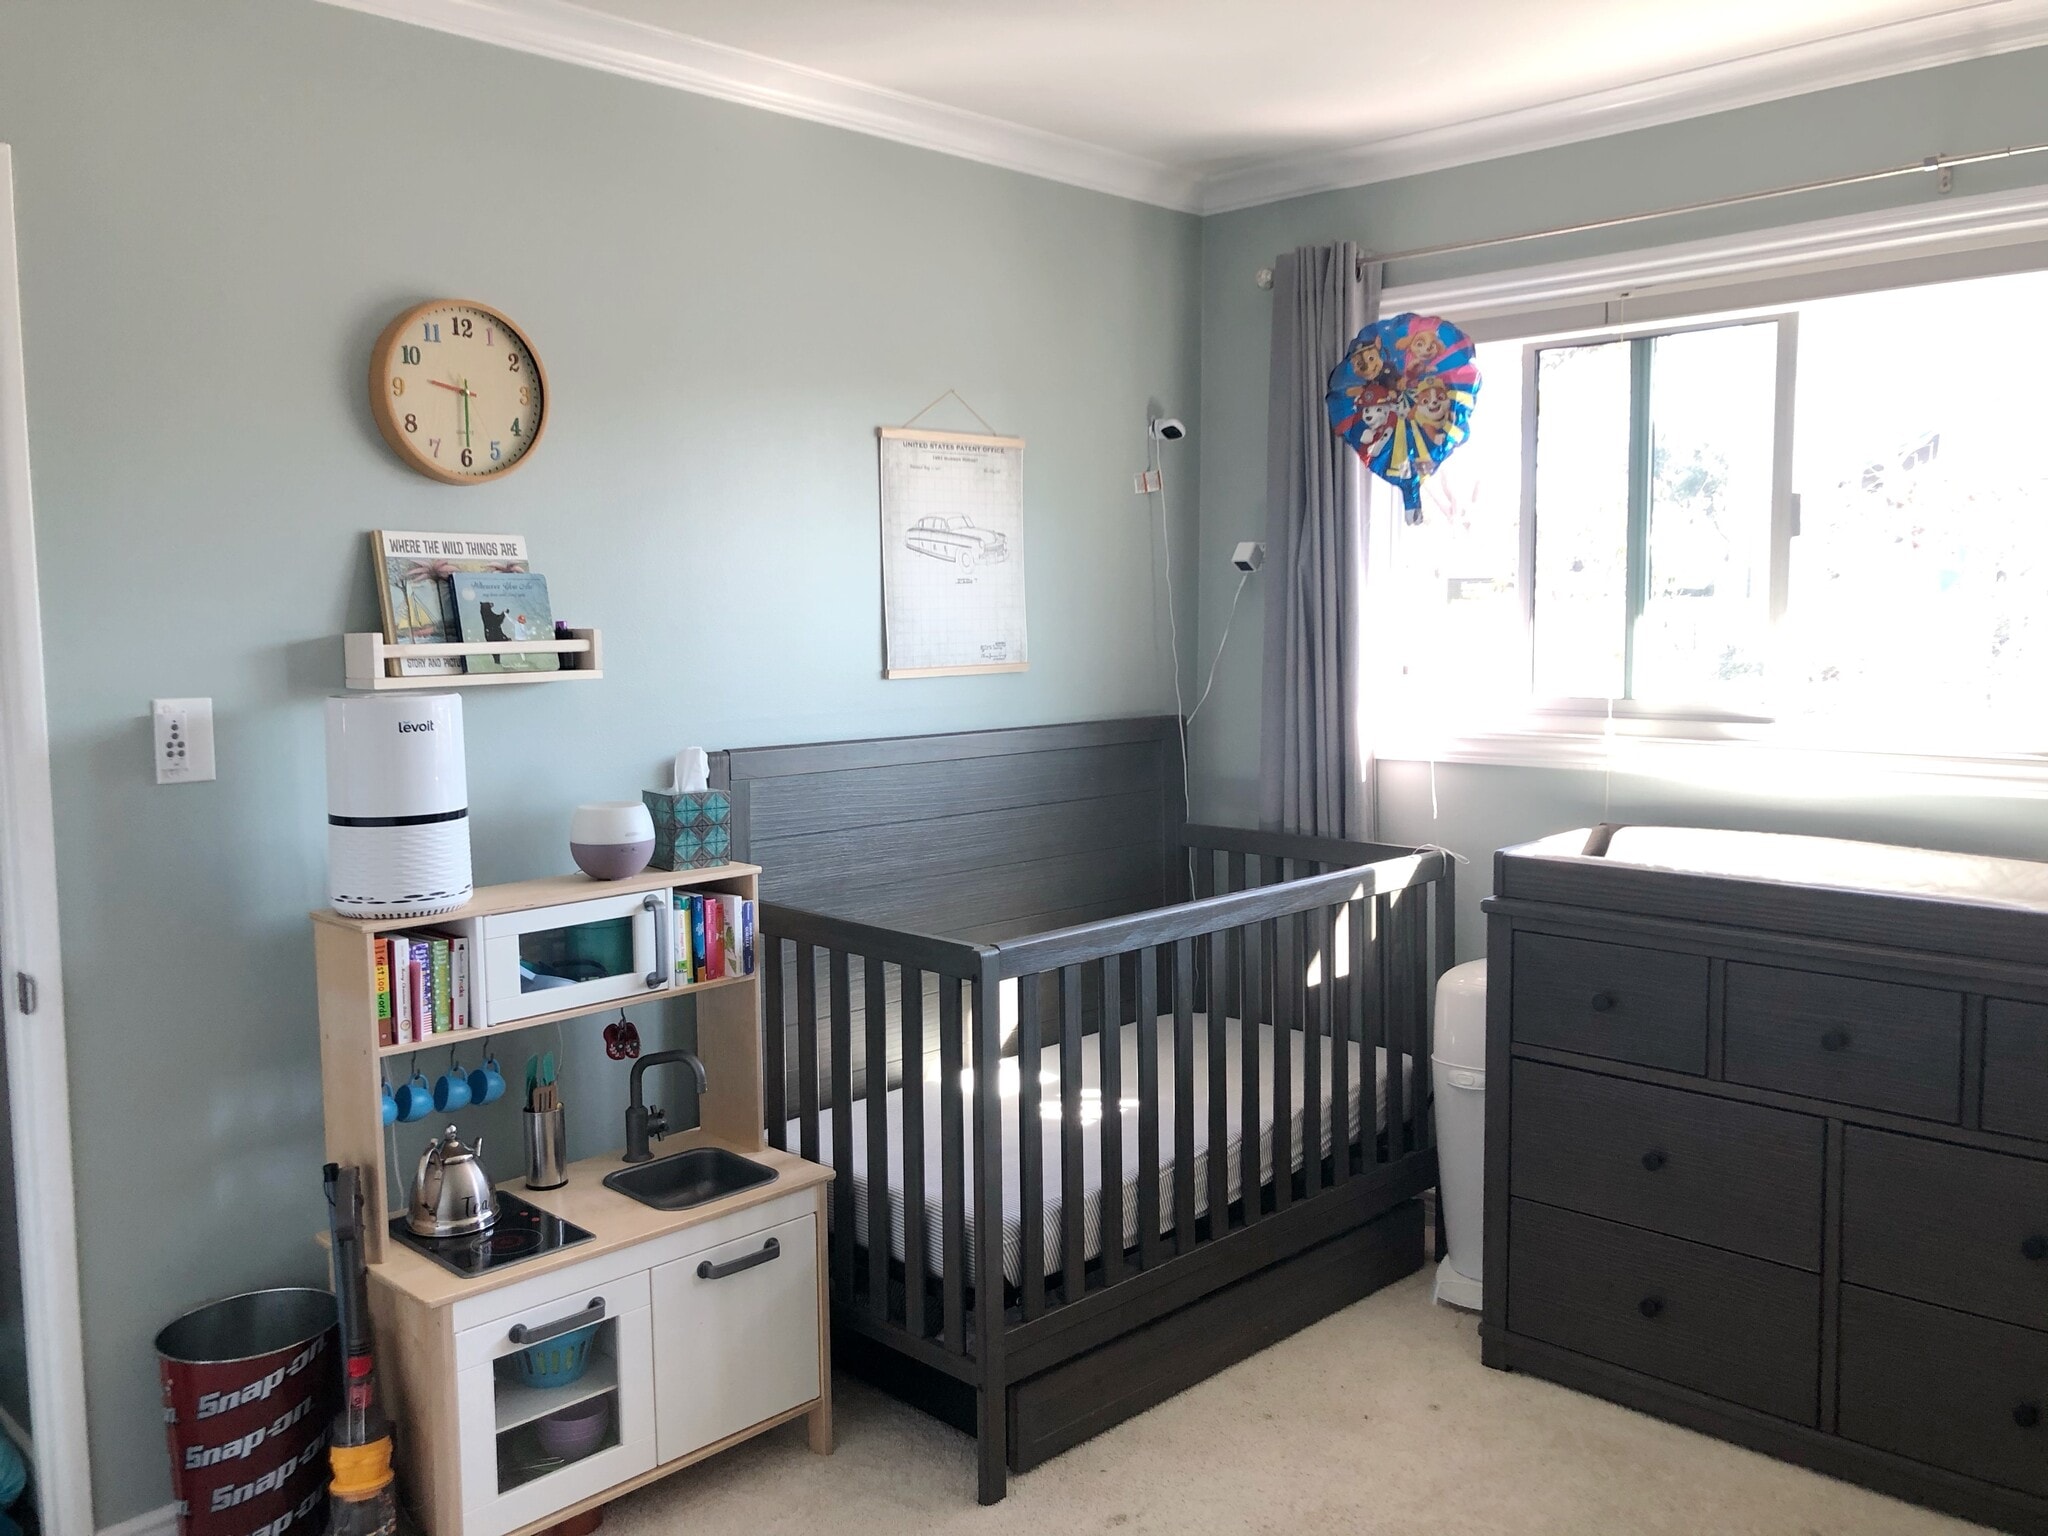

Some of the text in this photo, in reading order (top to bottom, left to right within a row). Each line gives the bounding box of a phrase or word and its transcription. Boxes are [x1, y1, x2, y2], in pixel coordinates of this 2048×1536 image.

[423, 322, 441, 343] 11
[451, 316, 473, 339] 12
[486, 327, 494, 347] 1
[401, 345, 421, 366] 10
[508, 353, 520, 373] 2
[392, 376, 405, 396] 9
[520, 386, 530, 406] 3
[404, 414, 418, 433] 8
[510, 418, 522, 437] 4
[428, 438, 441, 458] 7
[490, 441, 501, 461] 5
[902, 440, 928, 450] UNITED
[930, 443, 954, 451] STATES
[982, 446, 1005, 454] OFFICE
[461, 448, 473, 468] 6
[389, 538, 518, 556] WHERE THE WILD THINGS ARE
[406, 658, 426, 668] STORY
[428, 658, 441, 668] AND
[378, 978, 386, 992] 100
[378, 994, 386, 1018] words
[461, 1196, 490, 1217] Tea
[196, 1333, 326, 1420] Snap-on
[185, 1396, 314, 1470] Snap-on
